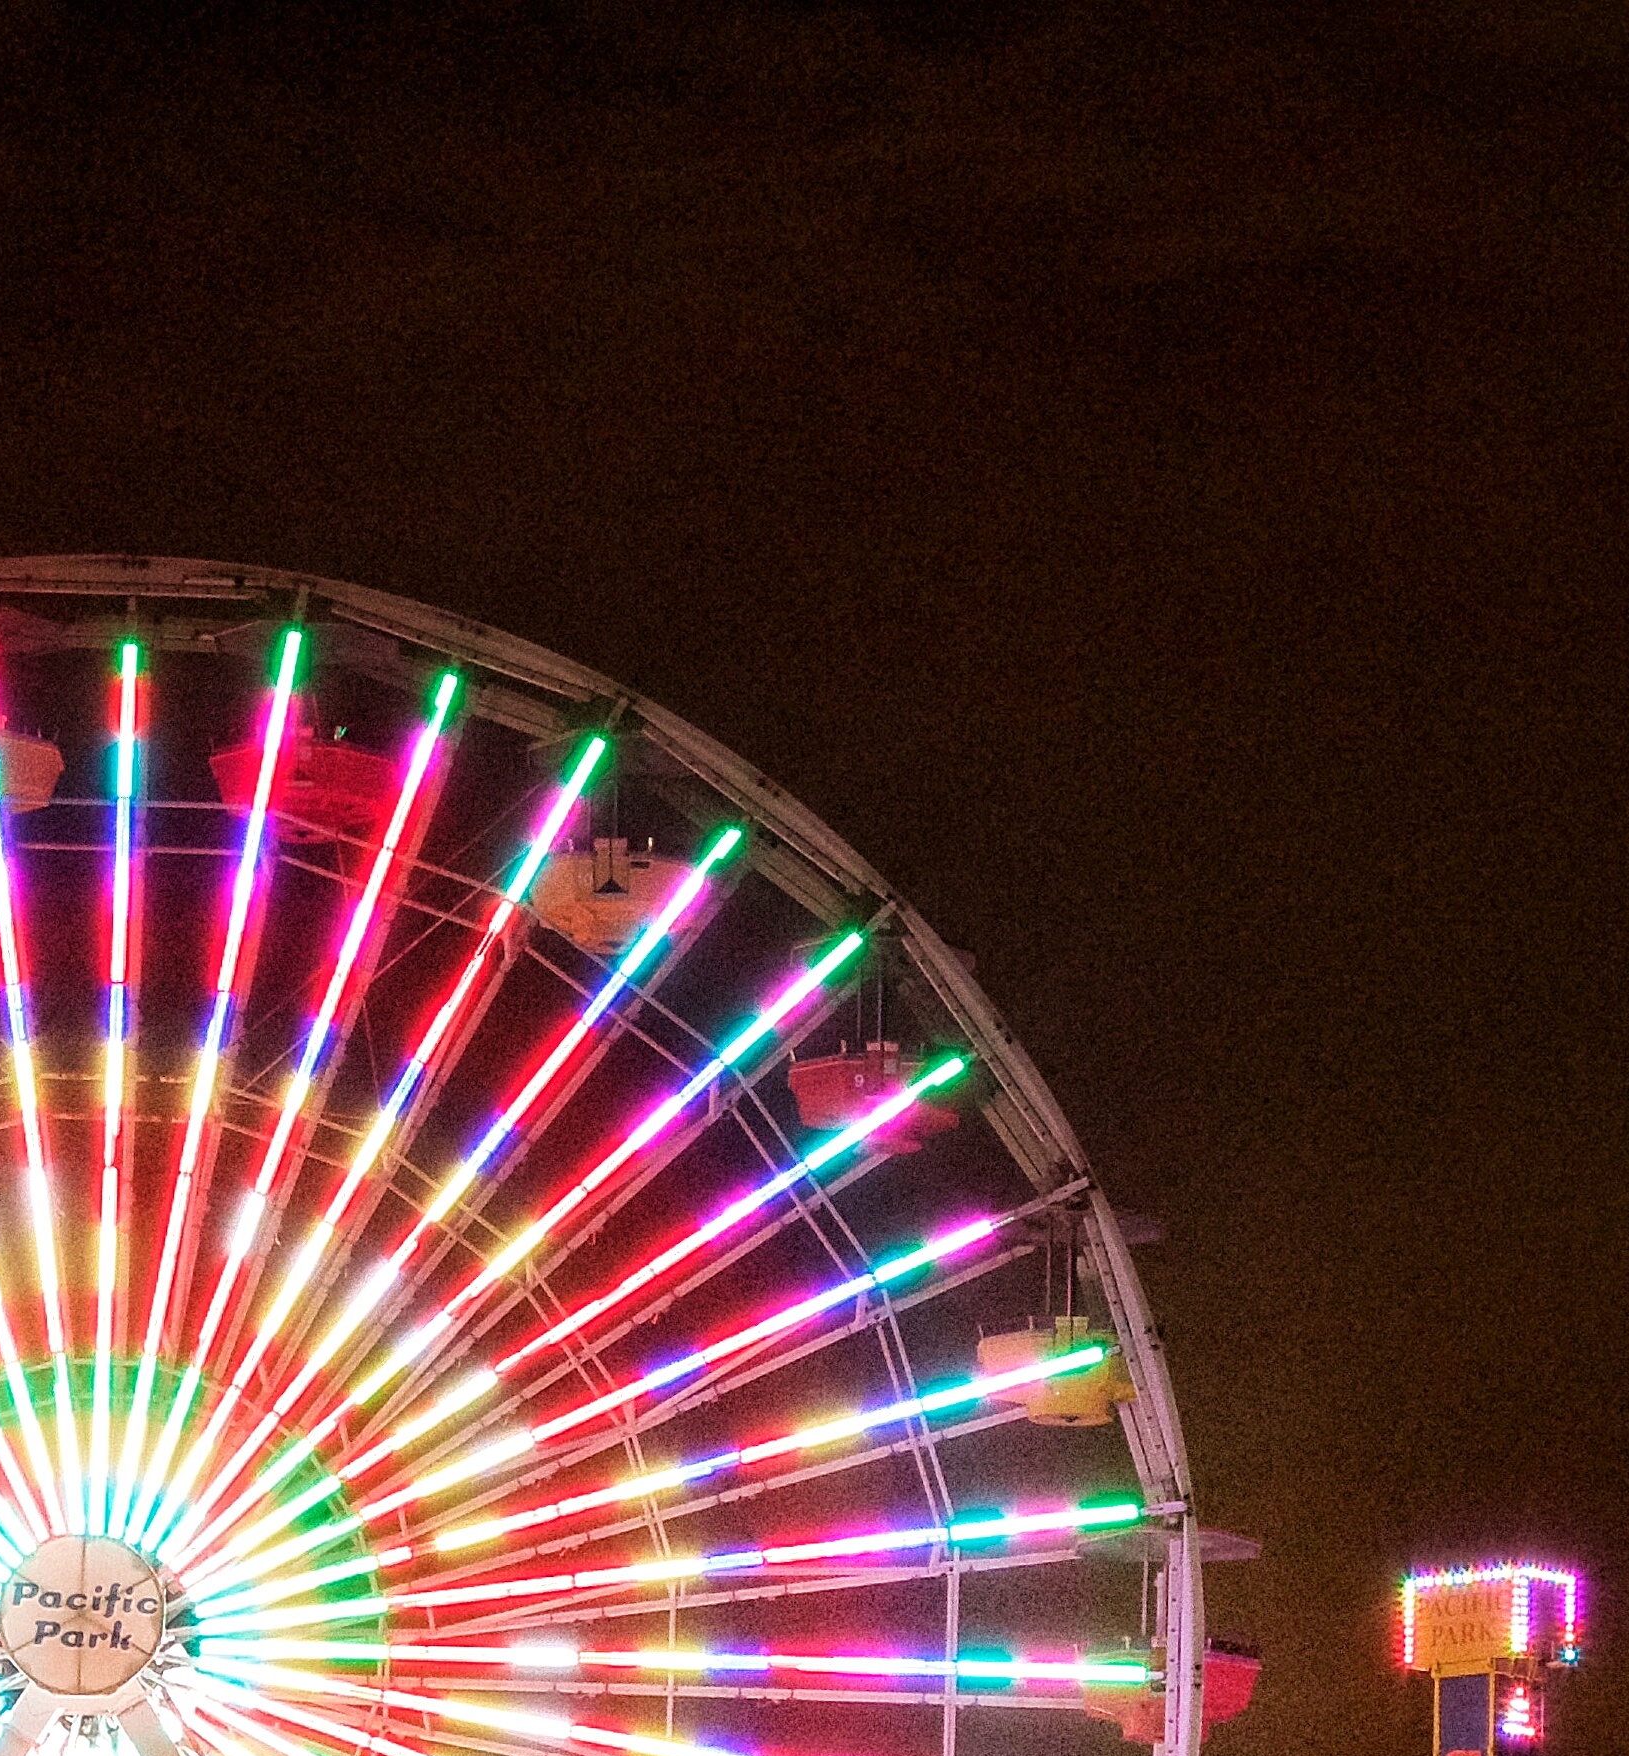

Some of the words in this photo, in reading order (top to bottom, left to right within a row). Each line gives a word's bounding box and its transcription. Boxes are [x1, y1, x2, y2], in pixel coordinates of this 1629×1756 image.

[854, 1073, 865, 1088] 9
[12, 1582, 159, 1618] Pacific
[34, 1620, 133, 1650] Park
[1431, 1621, 1493, 1648] PARK
